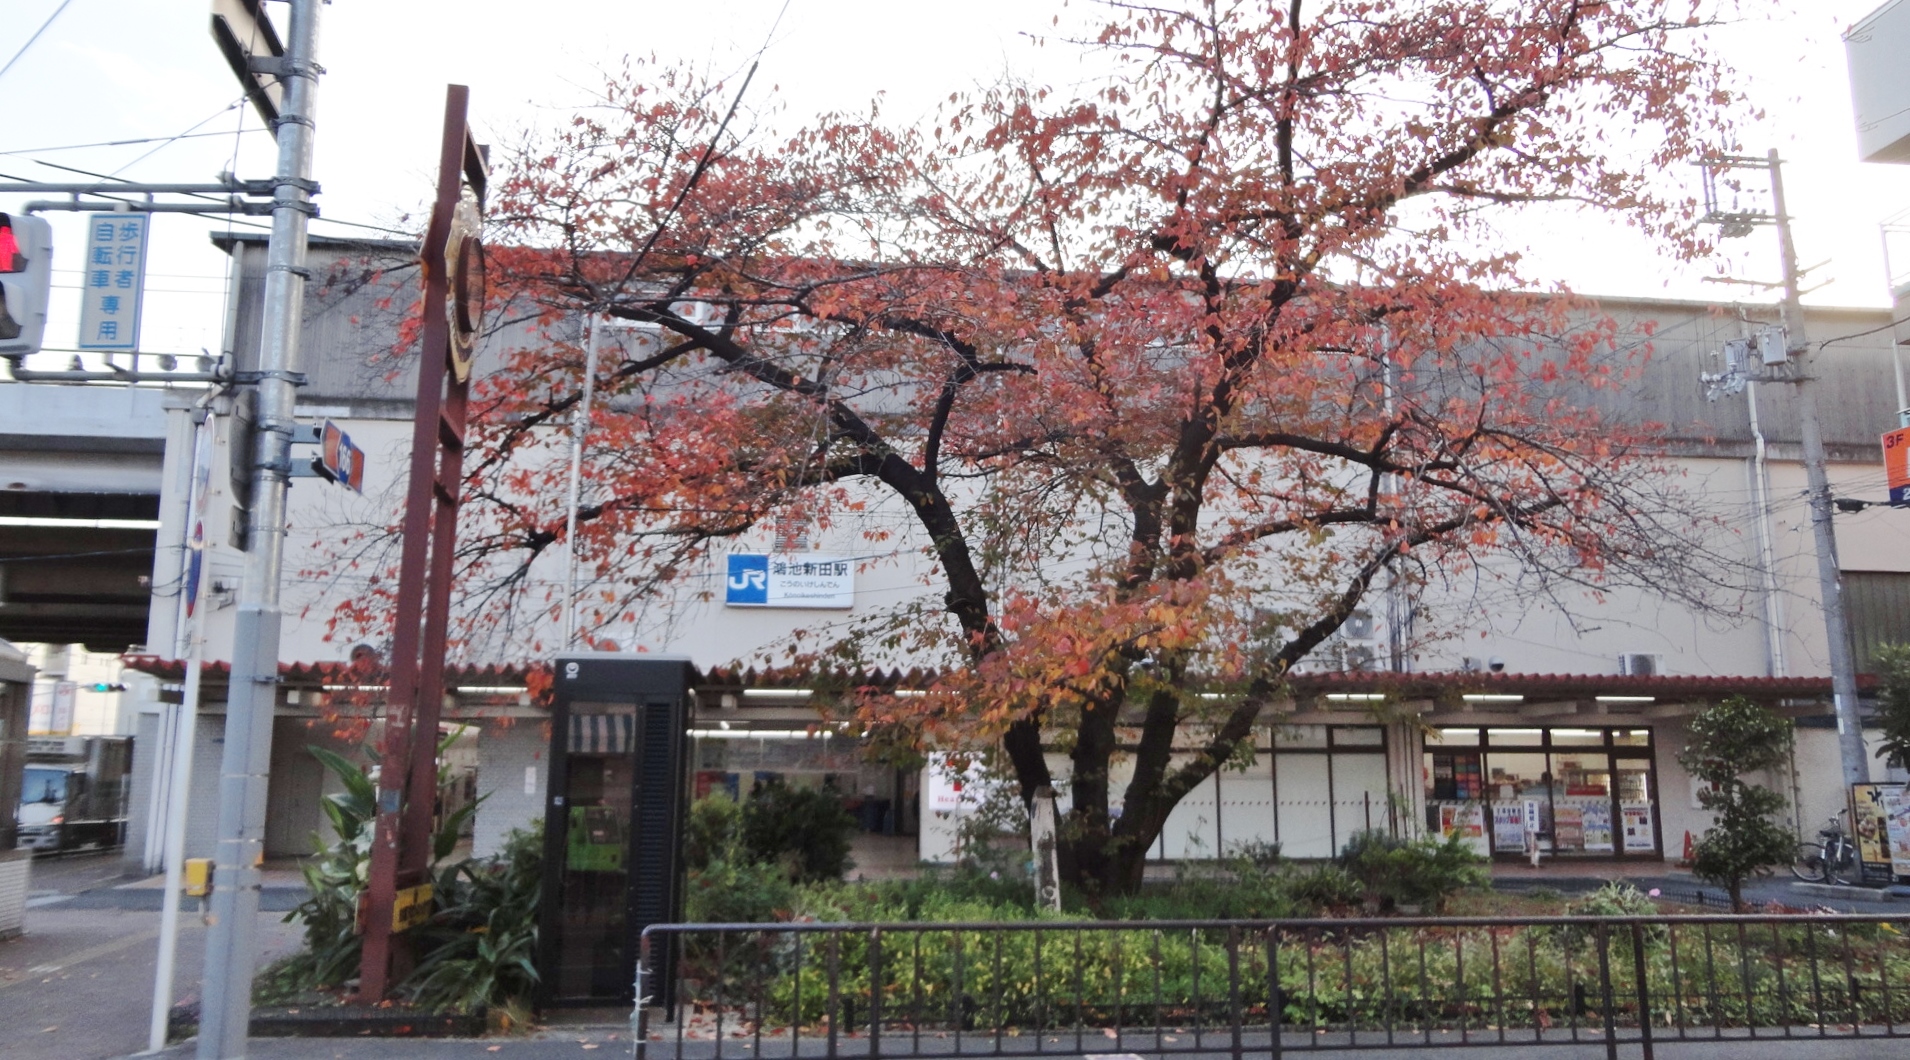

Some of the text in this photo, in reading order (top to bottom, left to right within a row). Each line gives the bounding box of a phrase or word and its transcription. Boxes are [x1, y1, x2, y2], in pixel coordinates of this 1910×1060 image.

[90, 222, 114, 288] 自転車
[115, 222, 139, 288] 歩行者
[97, 295, 120, 340] 専用
[1886, 433, 1904, 449] 3F
[729, 569, 766, 590] JR
[773, 562, 848, 576] 鴻池新田駅
[780, 580, 840, 589] こうのいけしんでん
